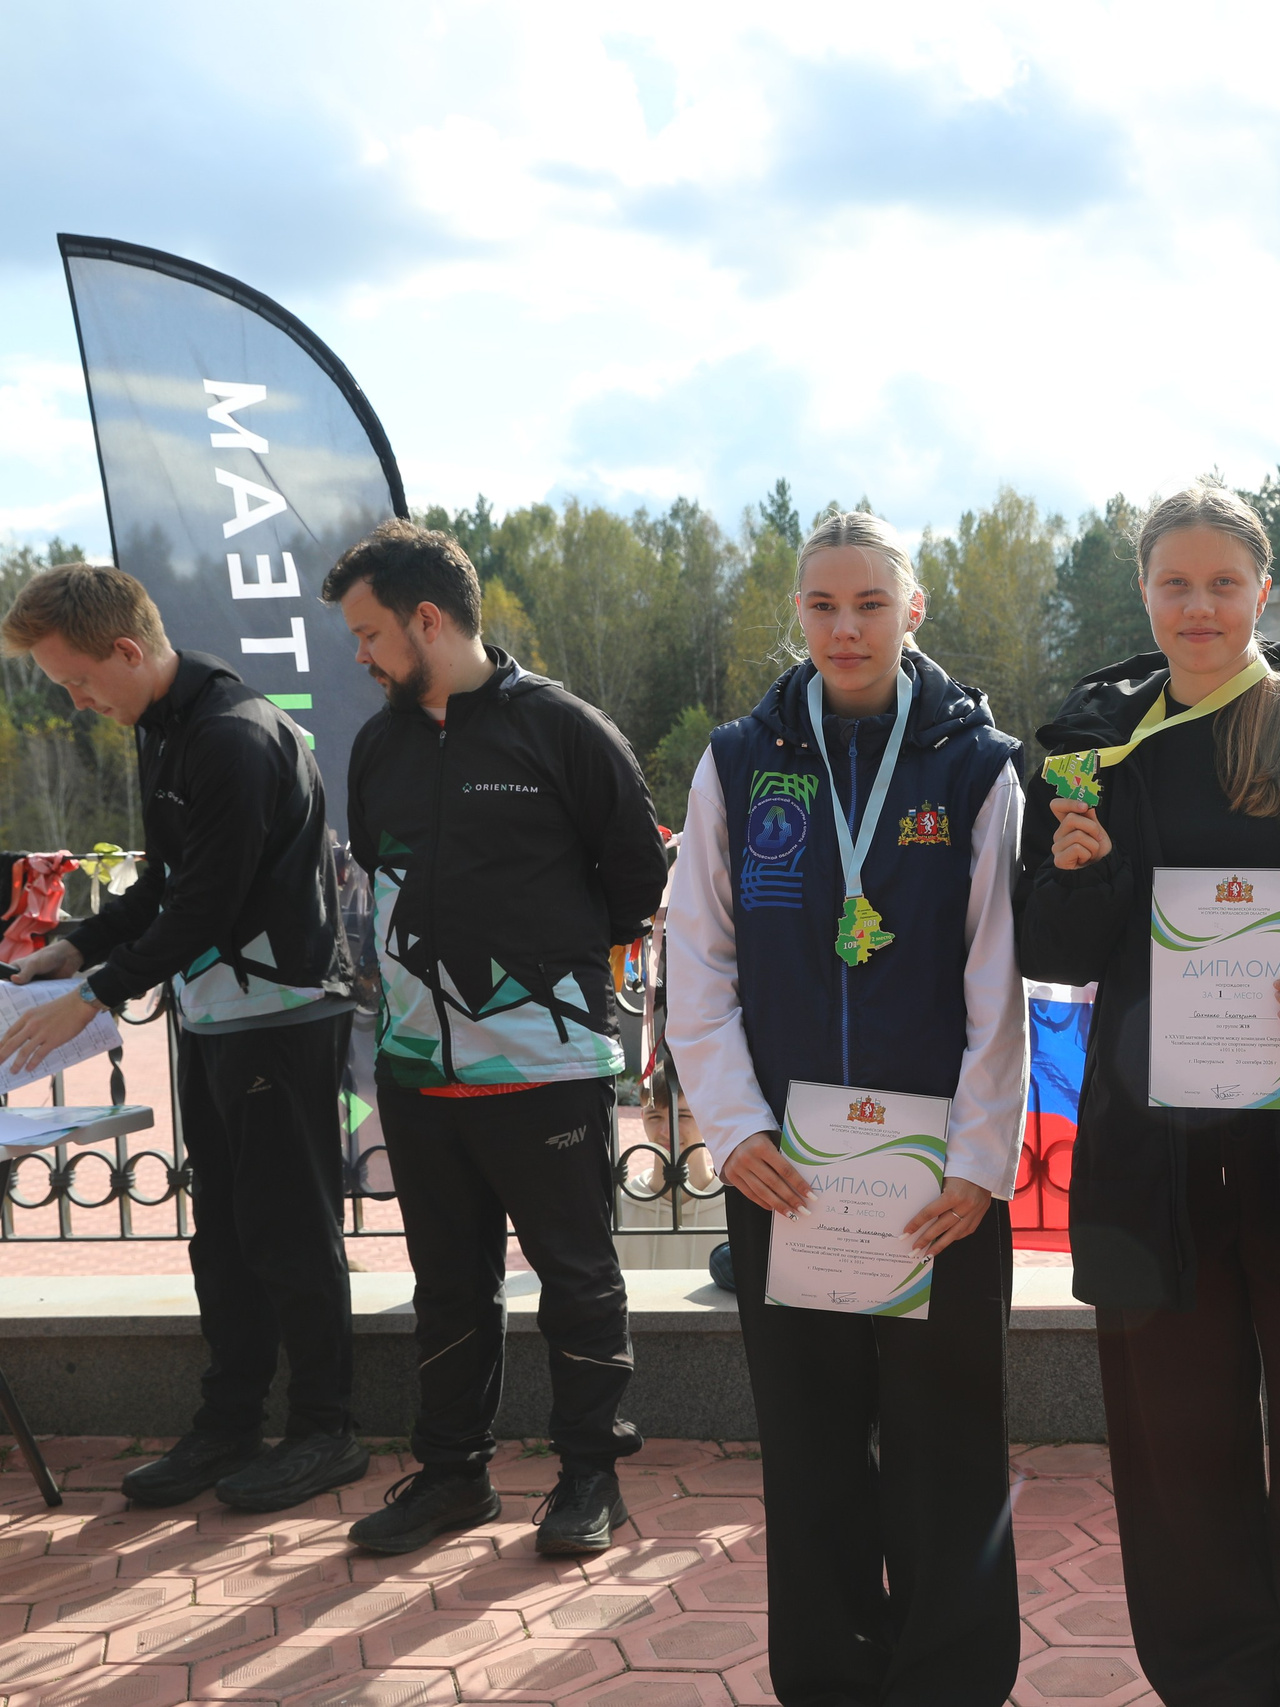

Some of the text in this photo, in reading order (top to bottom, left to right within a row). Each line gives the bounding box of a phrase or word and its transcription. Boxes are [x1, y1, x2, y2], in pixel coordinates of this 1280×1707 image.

[1068, 760, 1078, 774] 101
[475, 783, 539, 794] ORIENTEAM
[863, 920, 877, 928] 101
[843, 941, 858, 950] 101
[1202, 990, 1264, 1000] ЗА 1 МЕСТО
[809, 1174, 908, 1200] ДИПЛОМ
[826, 1205, 886, 1218] ЗА 2 МЕСТО
